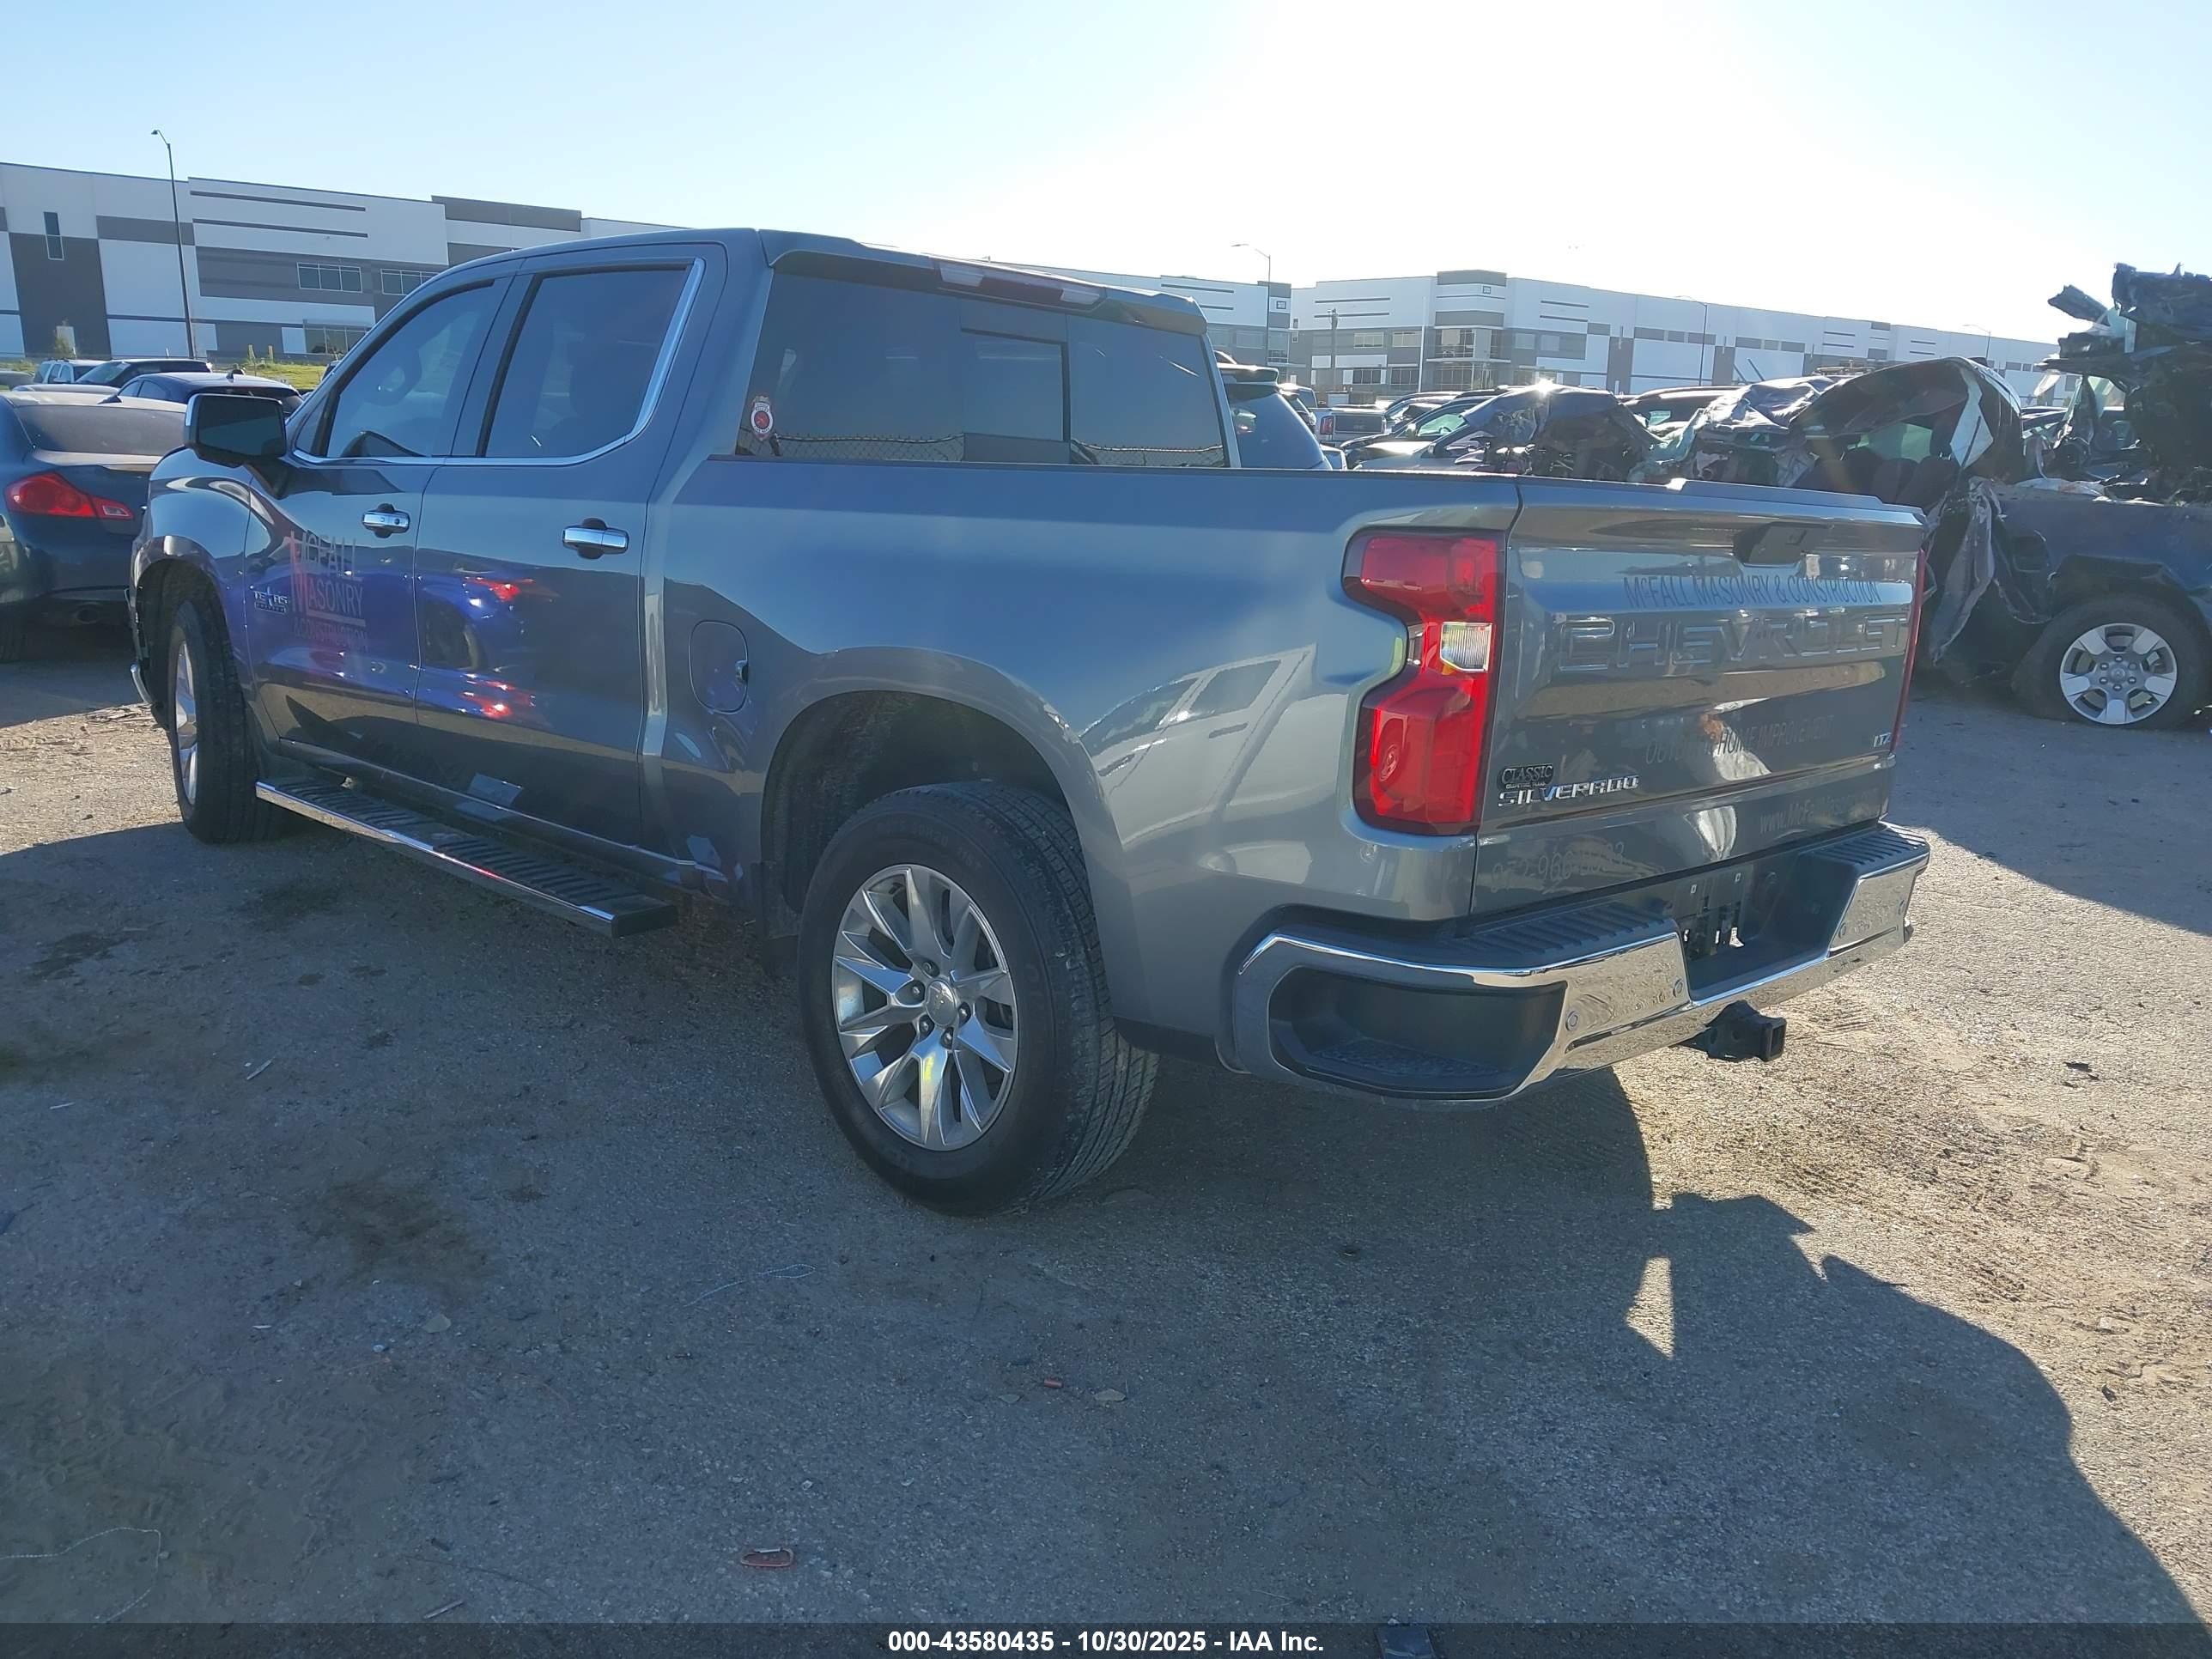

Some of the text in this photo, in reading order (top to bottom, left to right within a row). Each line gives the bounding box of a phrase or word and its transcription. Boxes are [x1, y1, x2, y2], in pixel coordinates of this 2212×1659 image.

[253, 586, 289, 606] TEXAS
[1692, 575, 1772, 605] MASONRY
[1774, 574, 1788, 604] &
[1788, 575, 1881, 604] CONSTRUCTION
[1559, 611, 1907, 672] CHEVROLET
[1502, 765, 1553, 785] CLASSIC
[1498, 775, 1640, 807] SILVERADO
